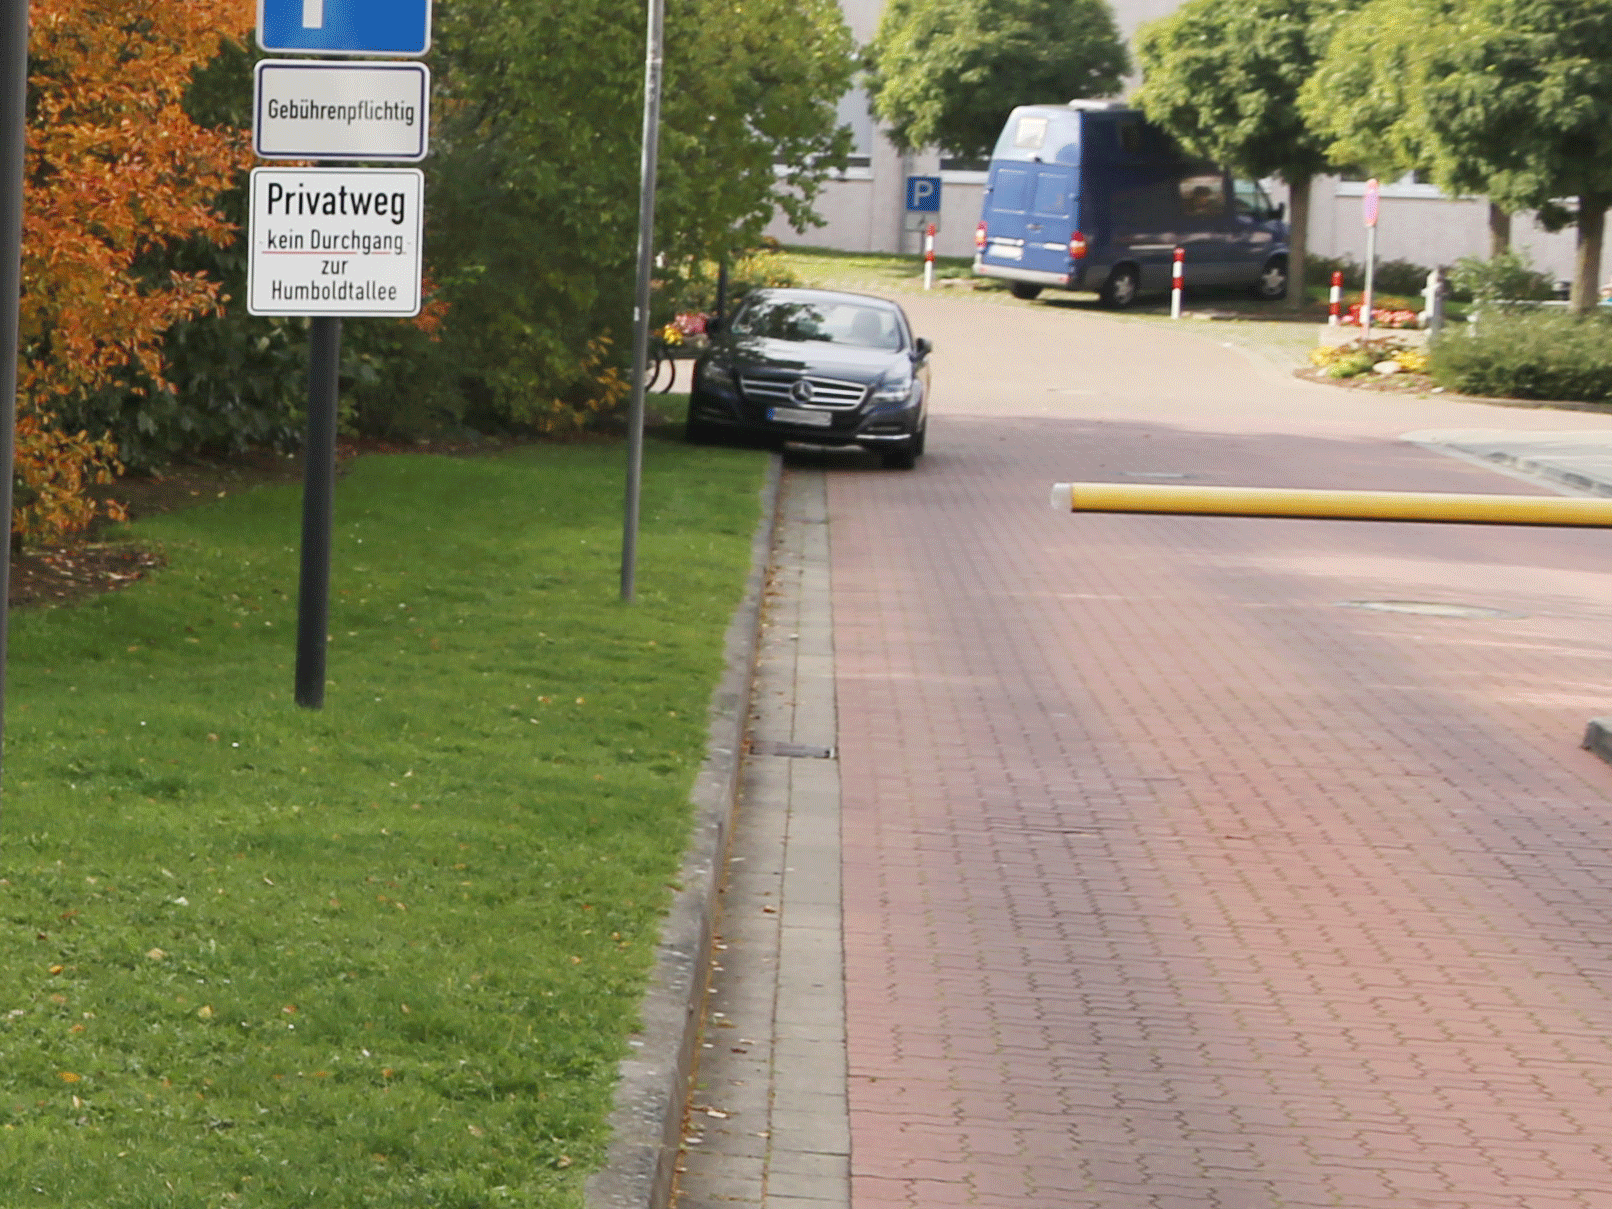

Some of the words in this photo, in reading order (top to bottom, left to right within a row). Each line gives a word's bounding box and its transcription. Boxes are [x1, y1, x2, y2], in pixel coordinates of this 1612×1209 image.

[268, 98, 415, 125] Gebührenpflichtig
[267, 182, 406, 224] Privatweg
[267, 228, 304, 250] kein
[310, 229, 404, 255] Durchgang
[321, 259, 348, 275] zur
[271, 279, 397, 301] Humboldtallee
